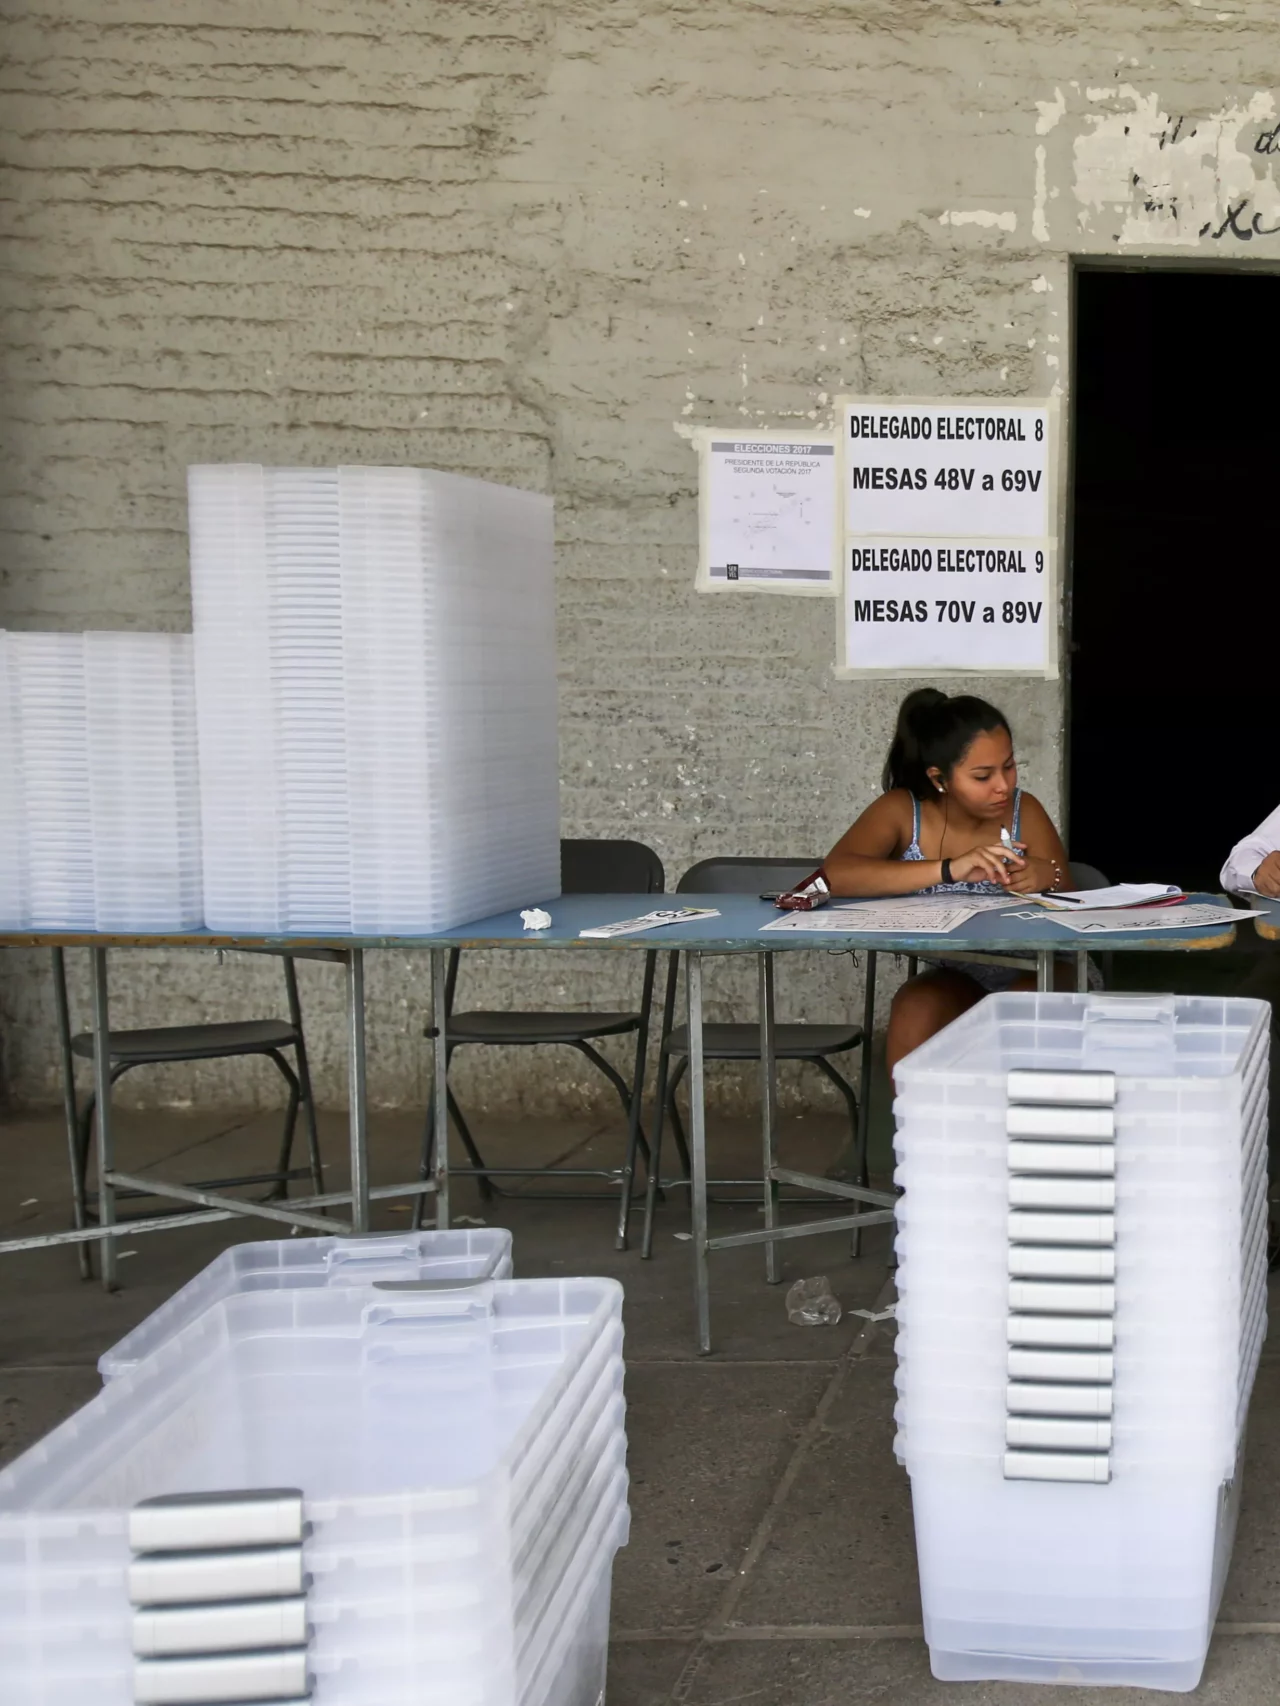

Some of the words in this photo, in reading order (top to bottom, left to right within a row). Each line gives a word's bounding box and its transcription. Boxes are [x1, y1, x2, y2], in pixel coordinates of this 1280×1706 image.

[850, 415, 932, 440] DELEGADO
[937, 417, 1026, 442] ELECTORAL
[1034, 418, 1044, 442] 8
[734, 443, 790, 454] ELECCIONES
[792, 445, 812, 455] 2017
[724, 458, 764, 468] PRESIDENTE
[765, 459, 774, 468] DE
[775, 460, 784, 468] LA
[733, 467, 764, 475] SEGUNDA
[853, 466, 928, 491] MESAS
[933, 467, 976, 492] 48V
[981, 475, 994, 491] a
[1001, 469, 1042, 492] 69V
[851, 548, 933, 573] DELEGADO
[937, 549, 1027, 573] ELECTORAL
[1035, 550, 1044, 573] 9
[854, 599, 928, 623] MESAS
[935, 600, 976, 623] 70V
[982, 607, 995, 623] a
[1001, 601, 1043, 624] 89V
